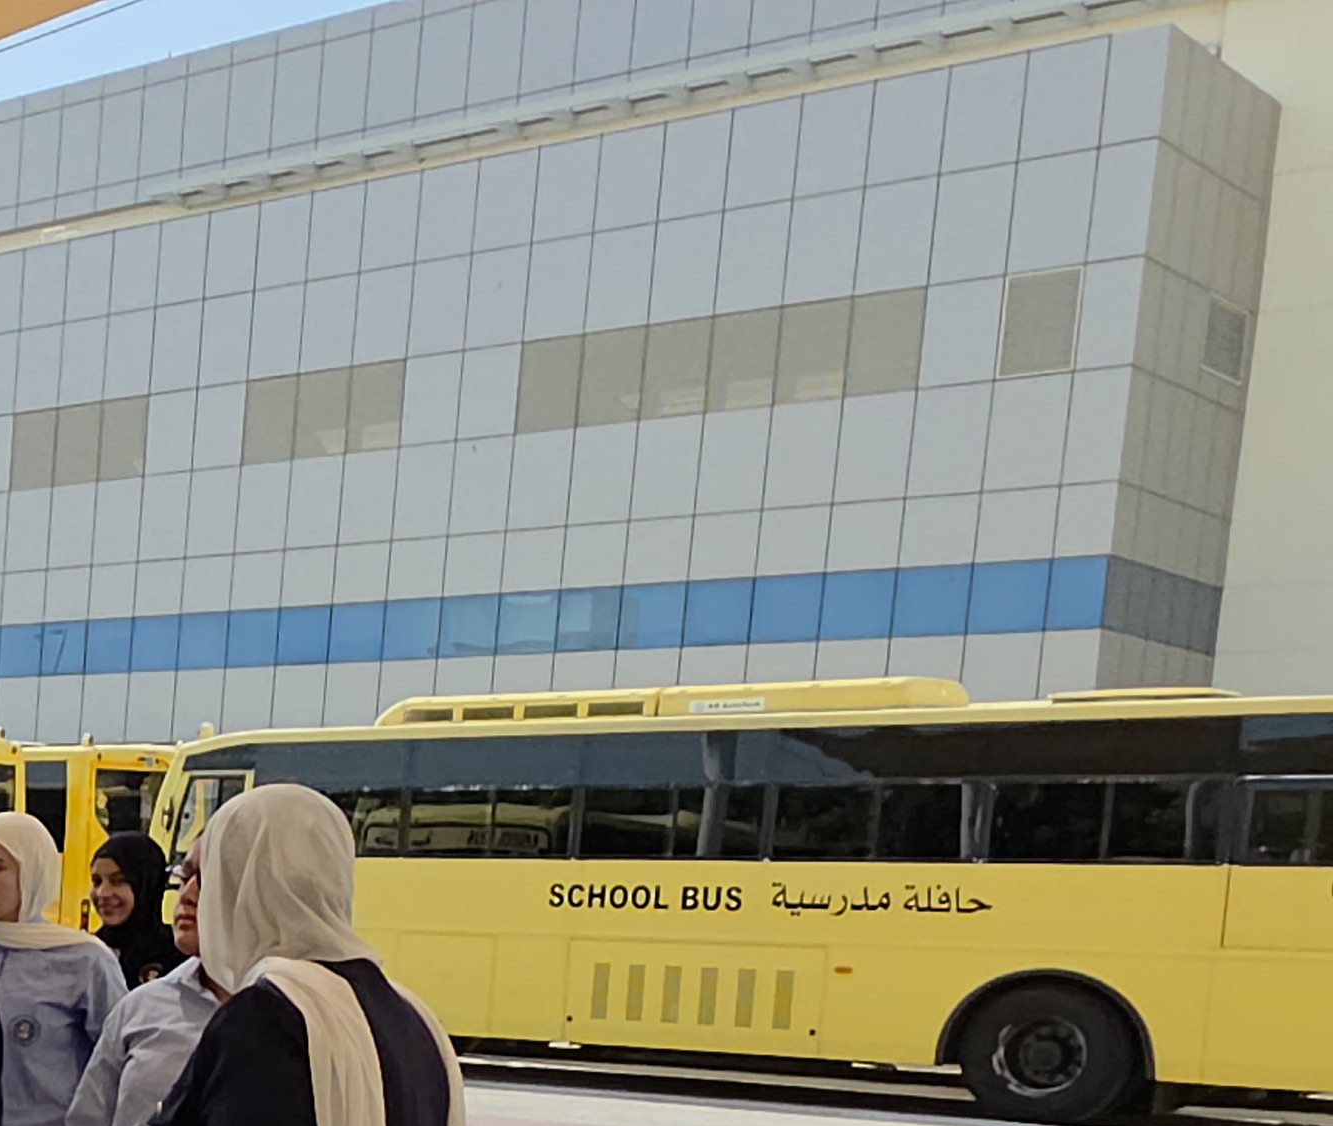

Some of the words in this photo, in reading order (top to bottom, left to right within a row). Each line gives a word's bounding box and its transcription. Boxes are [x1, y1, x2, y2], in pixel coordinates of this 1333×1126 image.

[549, 883, 669, 909] SCHOOL
[681, 886, 742, 911] BUS
[771, 882, 891, 916] مدرسية
[903, 884, 993, 914] حافلة
